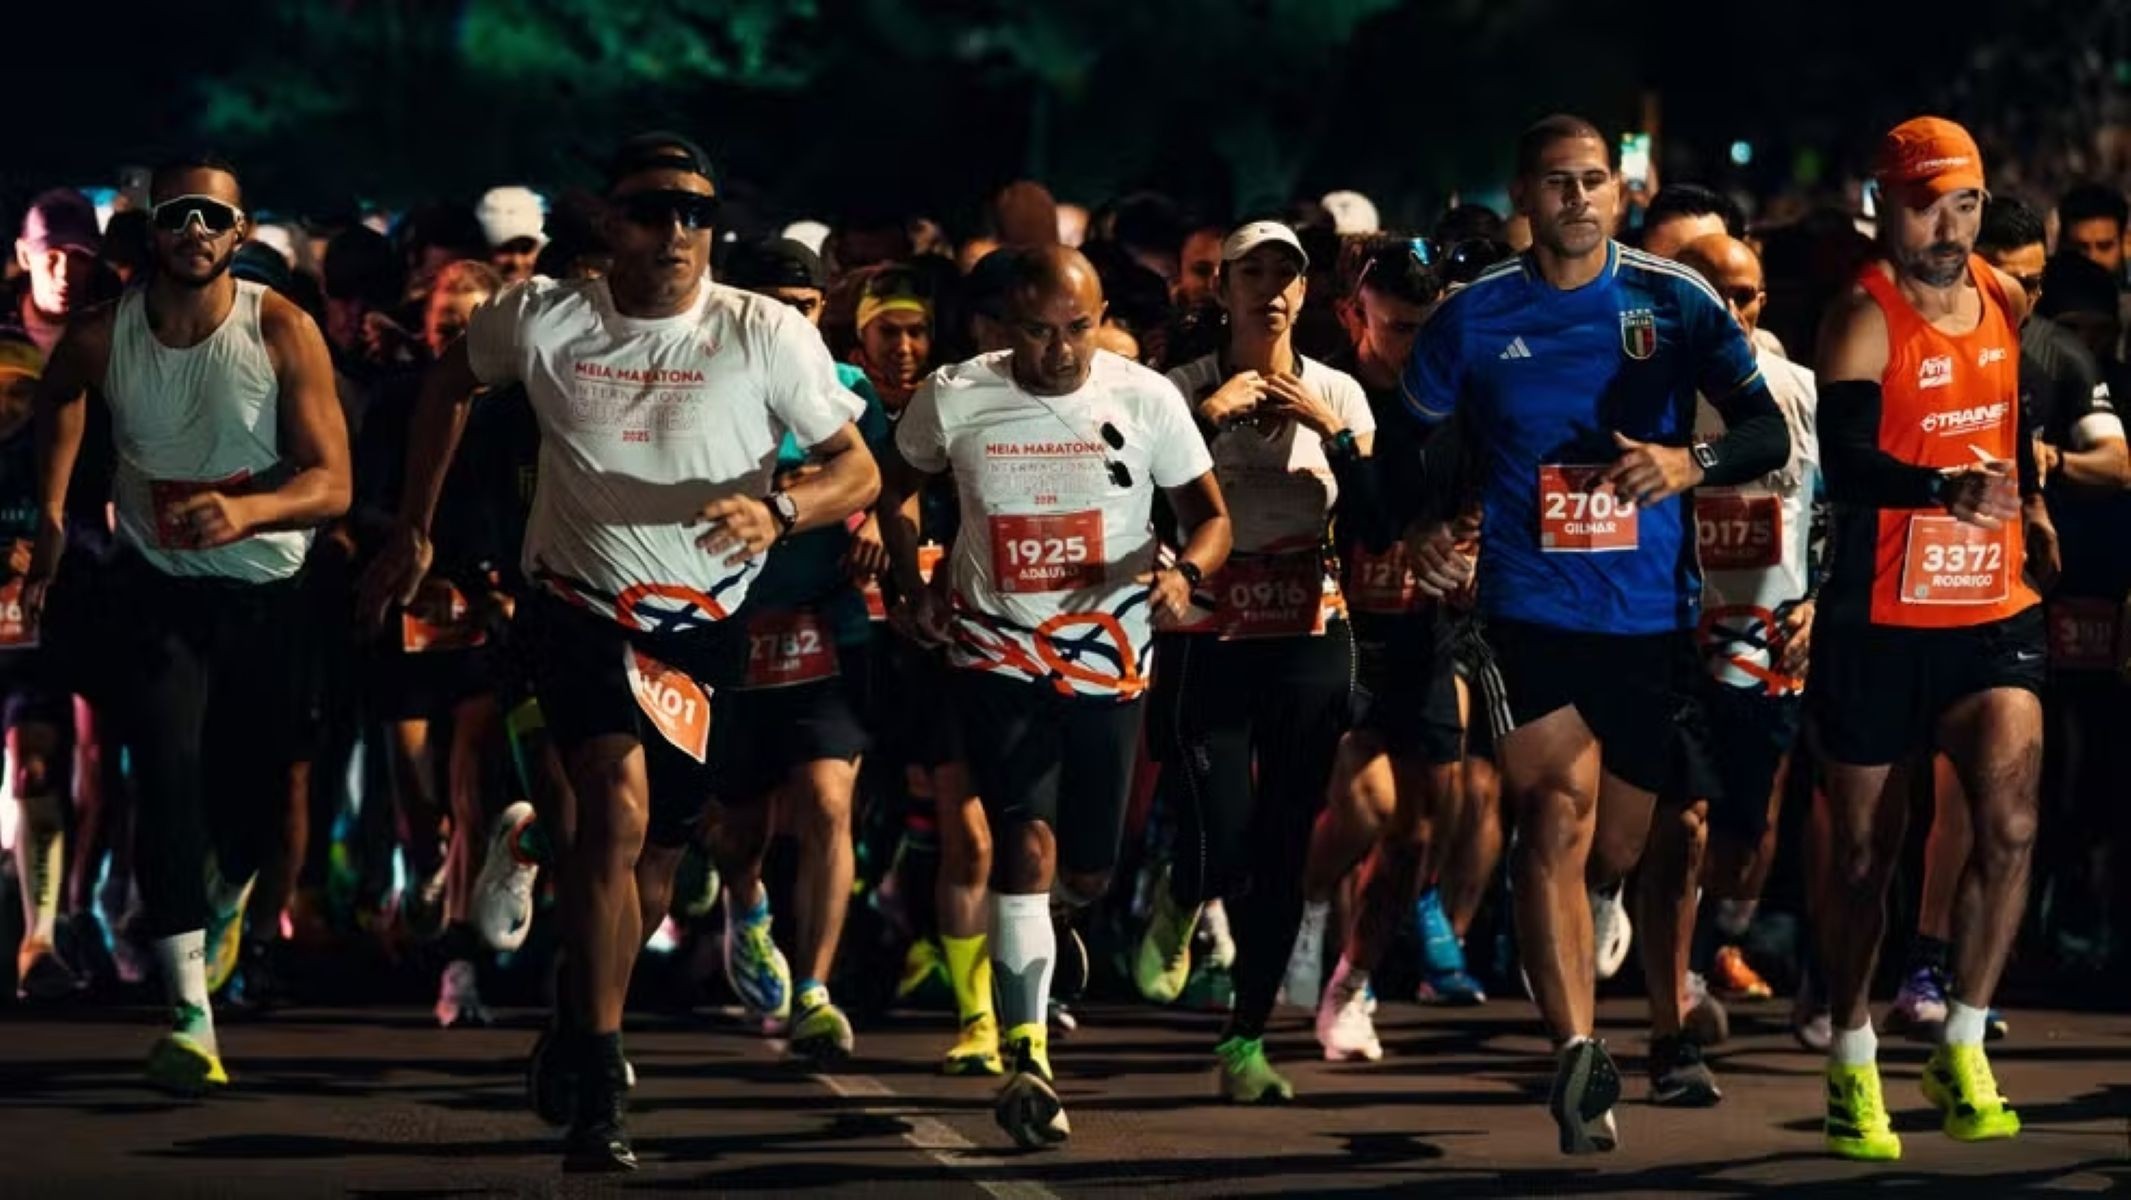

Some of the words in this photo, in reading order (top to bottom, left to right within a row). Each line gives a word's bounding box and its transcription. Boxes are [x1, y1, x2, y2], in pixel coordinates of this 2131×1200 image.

[574, 361, 612, 377] MEIA
[616, 369, 704, 383] MARATONA
[622, 430, 651, 442] 2025
[986, 443, 1020, 455] MEIA
[1024, 441, 1105, 455] MARATONA
[1564, 521, 1617, 535] GILMAR
[1006, 536, 1087, 565] 1925
[1922, 543, 2002, 572] 3372
[1932, 575, 1994, 588] RODRIGO
[1229, 580, 1308, 609] 0916
[749, 627, 823, 658] 2782
